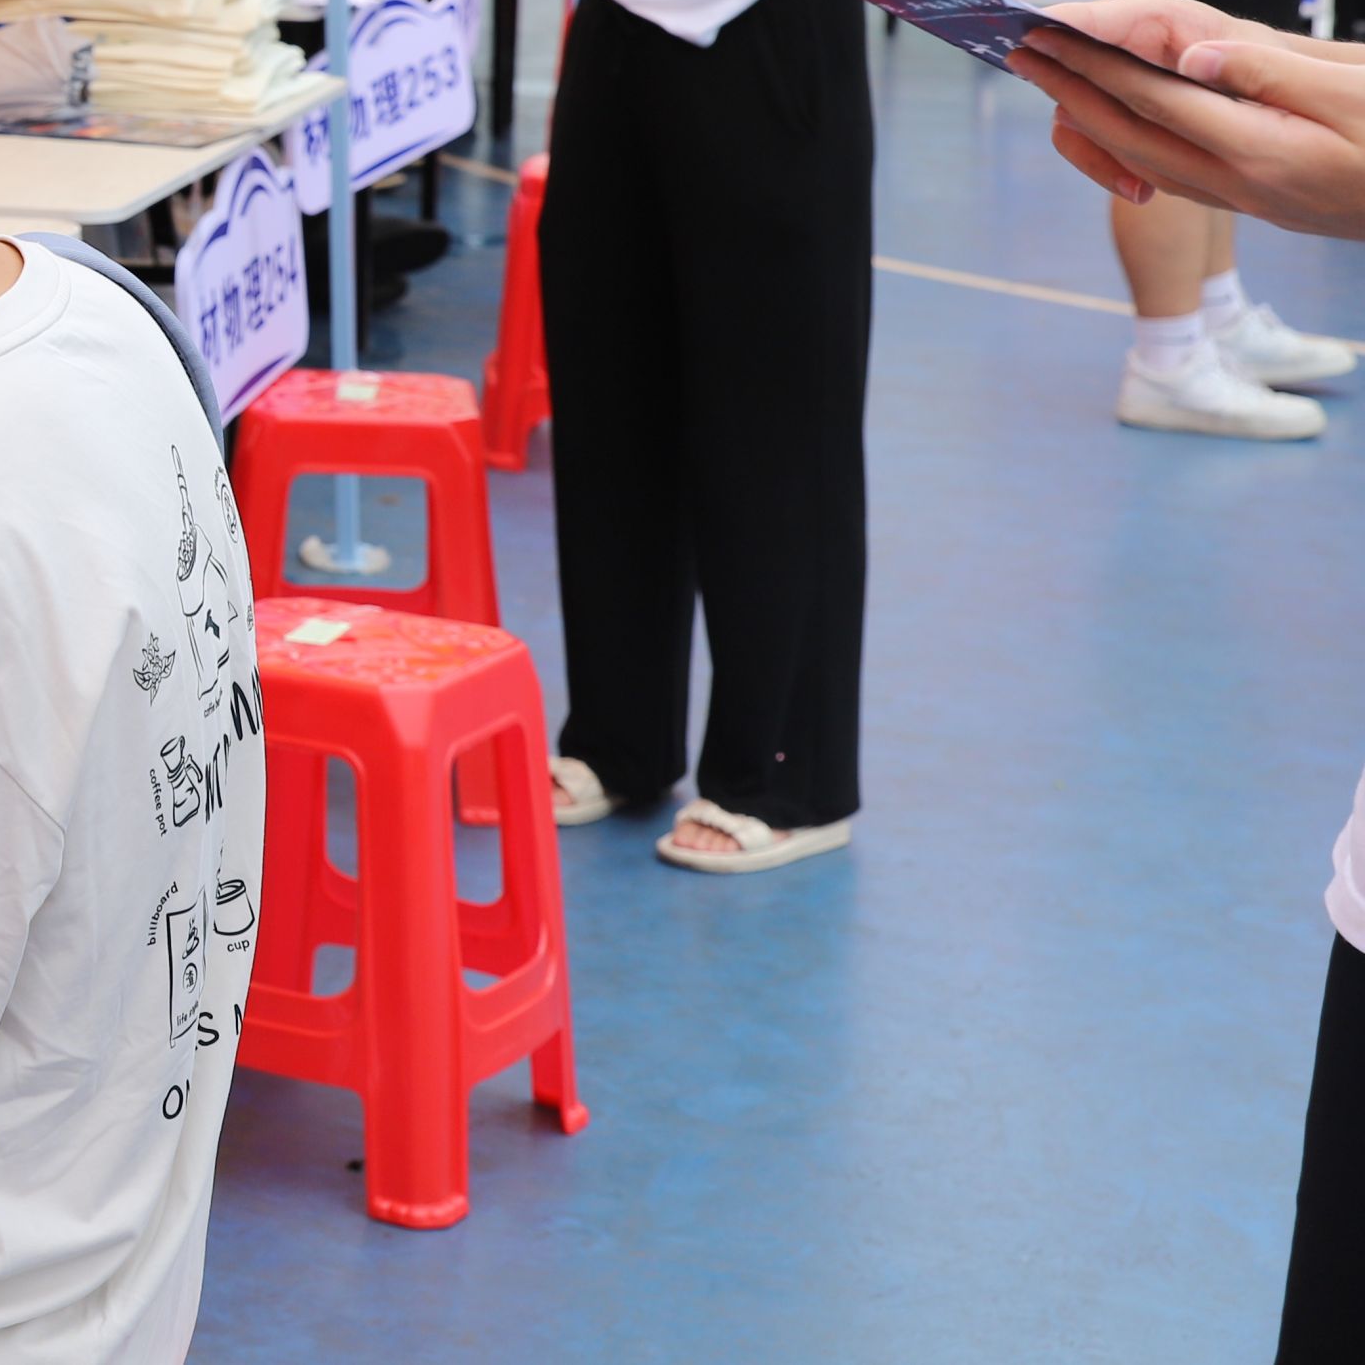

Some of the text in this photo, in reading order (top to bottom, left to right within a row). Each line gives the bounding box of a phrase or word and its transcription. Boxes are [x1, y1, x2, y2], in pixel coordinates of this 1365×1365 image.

[148, 768, 169, 838] coffee pot
[146, 881, 179, 947] billboard
[226, 938, 251, 953] cup
